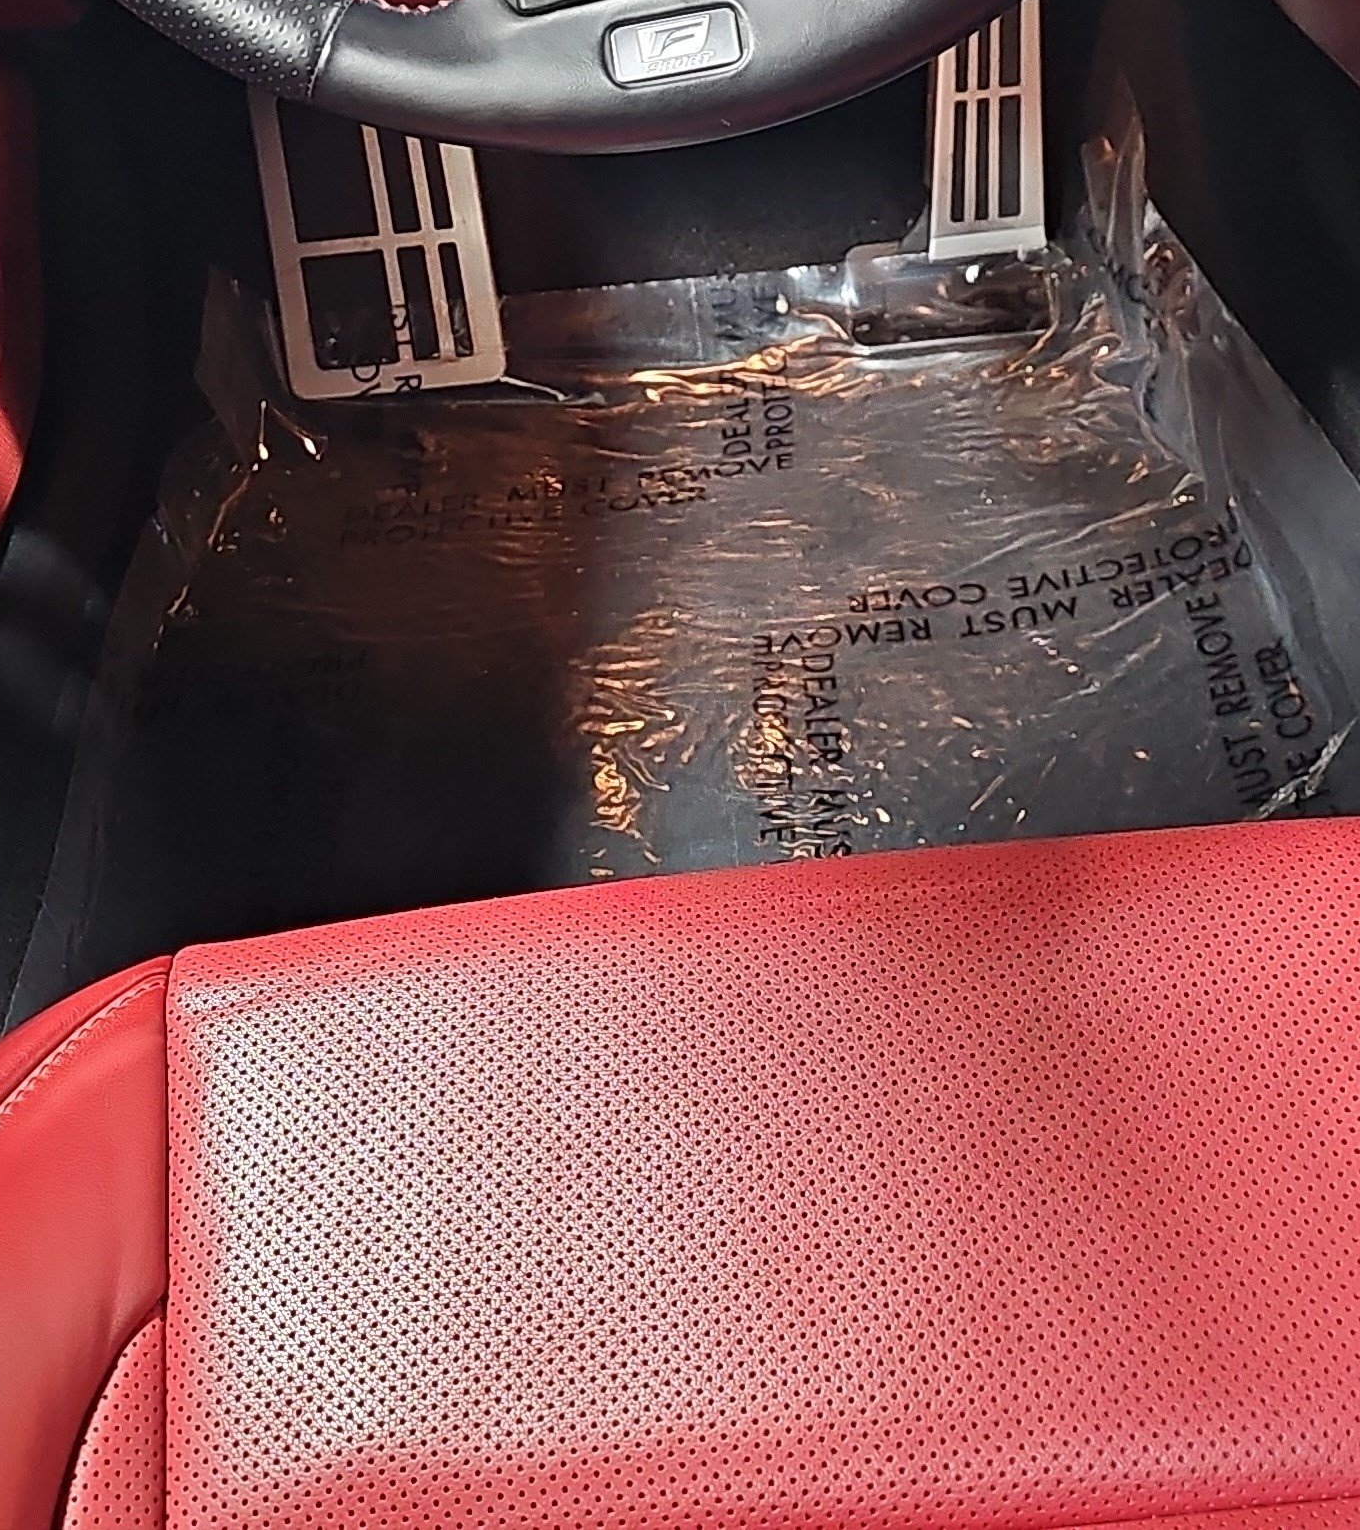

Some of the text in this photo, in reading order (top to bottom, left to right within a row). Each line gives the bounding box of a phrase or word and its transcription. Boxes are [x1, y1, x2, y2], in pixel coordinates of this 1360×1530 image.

[847, 582, 987, 613] COVER
[960, 594, 1078, 640] MUST
[1185, 591, 1253, 718] REMOVE
[1254, 635, 1314, 739] COVER
[802, 652, 844, 769] DEALER
